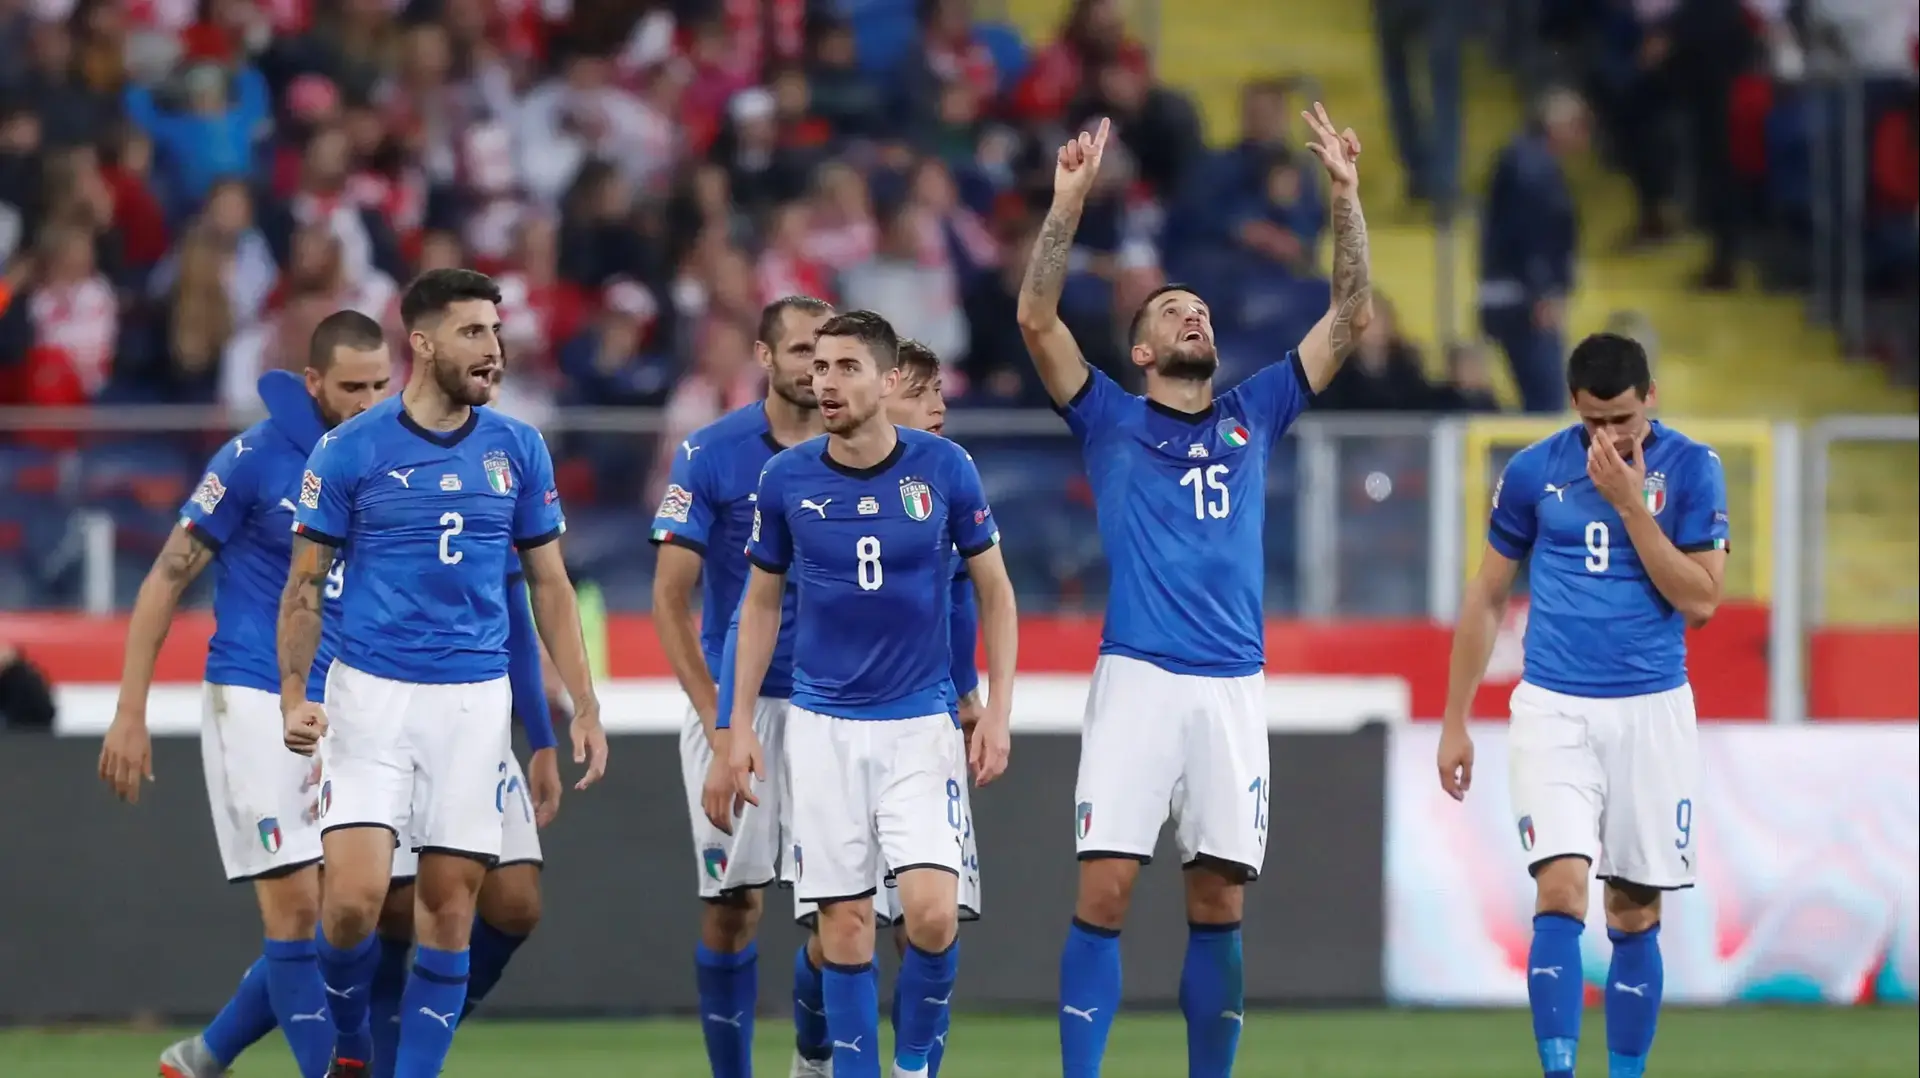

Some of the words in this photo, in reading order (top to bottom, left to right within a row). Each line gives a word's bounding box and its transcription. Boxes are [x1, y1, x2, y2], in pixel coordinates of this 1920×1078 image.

[902, 484, 926, 495] ITALIA
[1180, 464, 1229, 520] 15
[439, 512, 464, 565] 2
[856, 536, 883, 591] 8
[1585, 521, 1609, 573] 9
[946, 778, 960, 829] 8
[1675, 799, 1692, 849] 9
